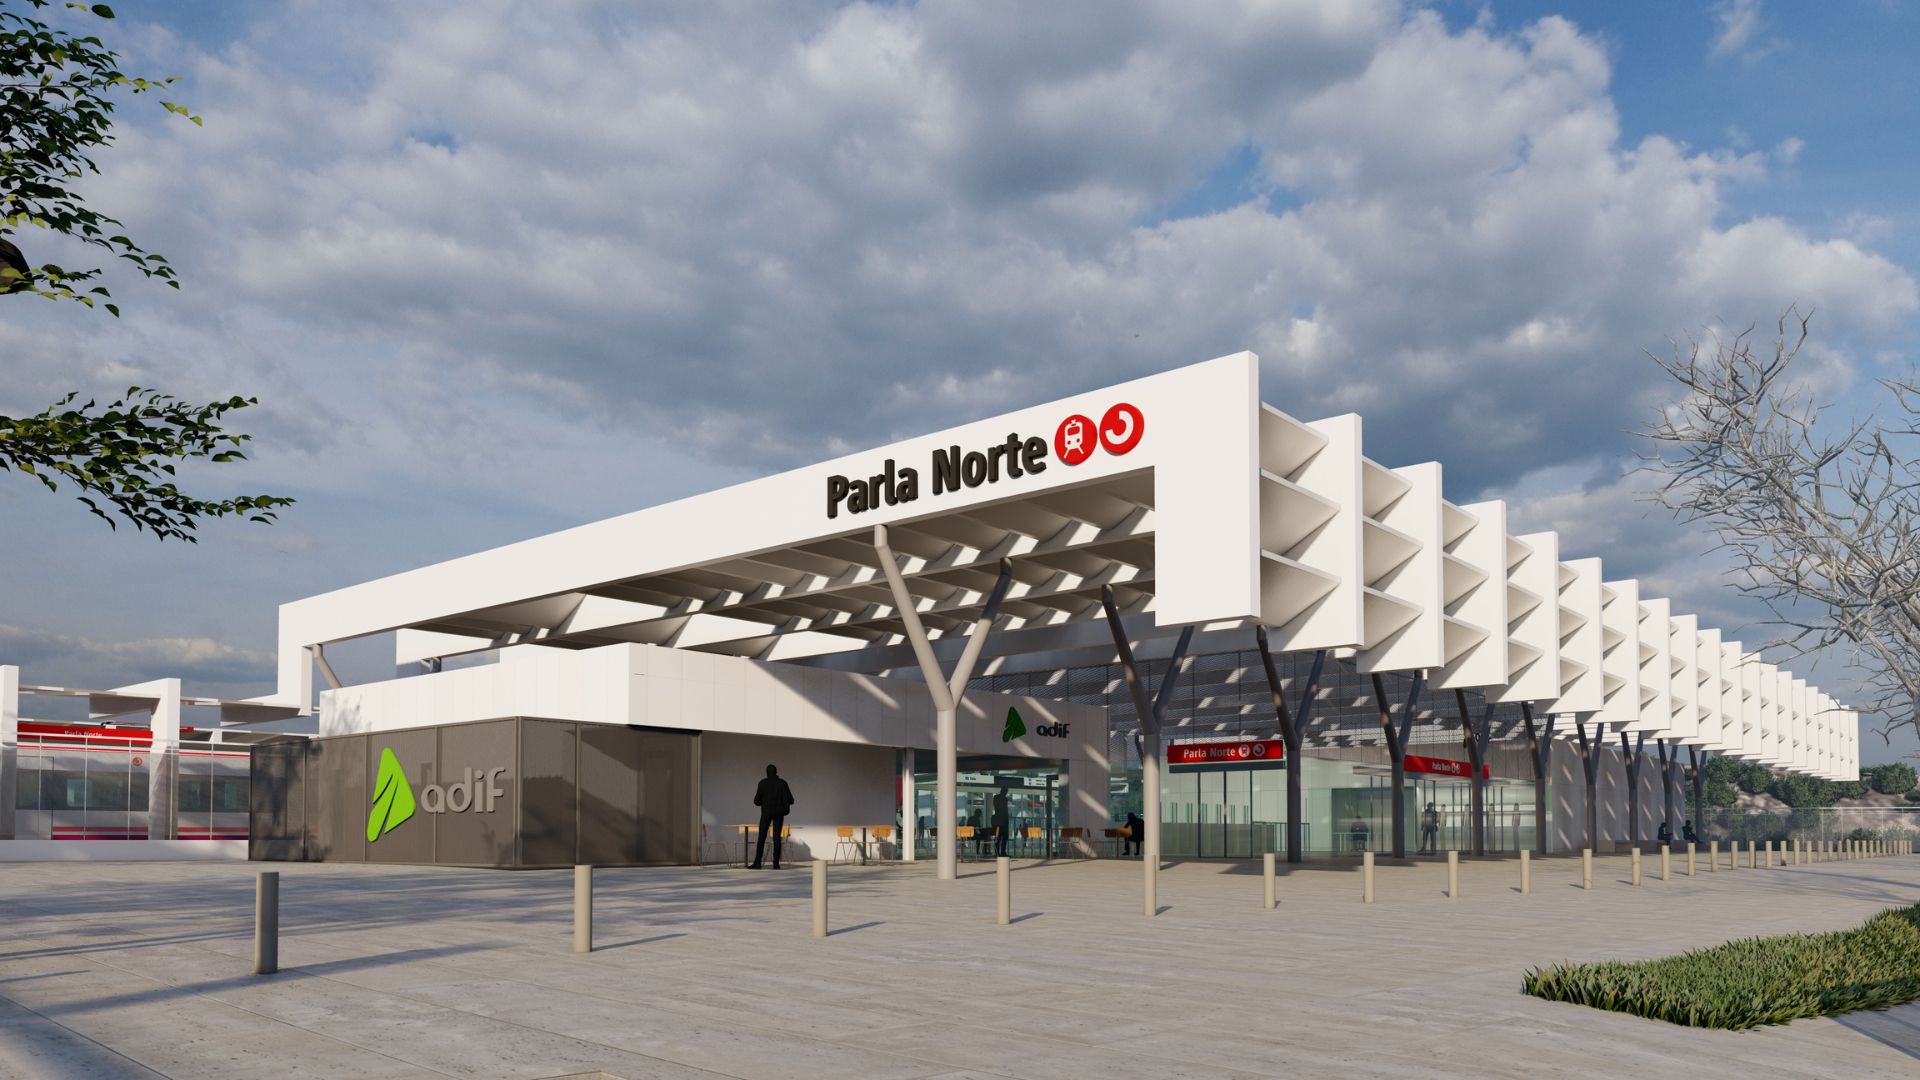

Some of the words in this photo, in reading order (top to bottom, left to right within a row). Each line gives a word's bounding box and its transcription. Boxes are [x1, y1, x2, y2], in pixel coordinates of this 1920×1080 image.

[827, 459, 918, 519] Parla
[932, 433, 1048, 495] Norte
[1036, 721, 1070, 738] adif
[1183, 748, 1206, 758] Parla
[1210, 747, 1235, 758] Norte
[420, 767, 506, 814] adif
